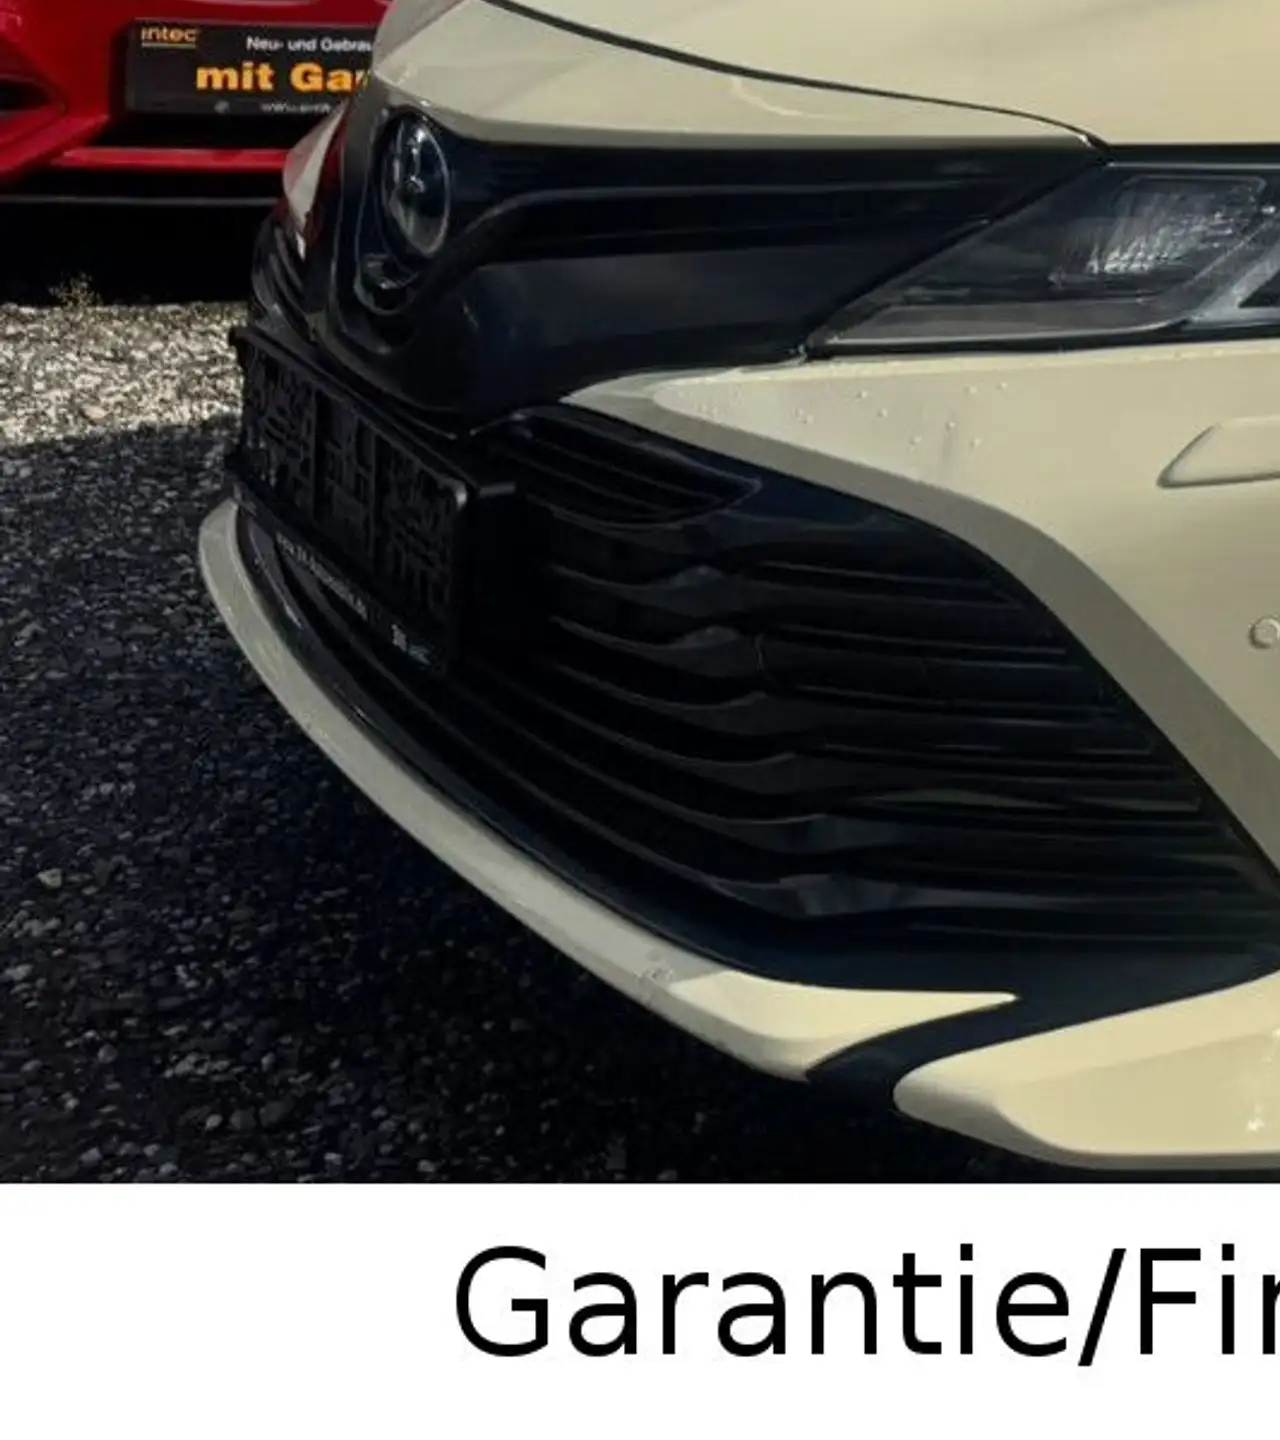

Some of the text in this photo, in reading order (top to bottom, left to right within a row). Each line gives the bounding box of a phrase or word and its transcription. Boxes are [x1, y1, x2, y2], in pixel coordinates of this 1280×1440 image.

[141, 26, 196, 42] intec
[245, 35, 284, 51] Neu-
[287, 38, 317, 51] und
[195, 61, 275, 91] mit
